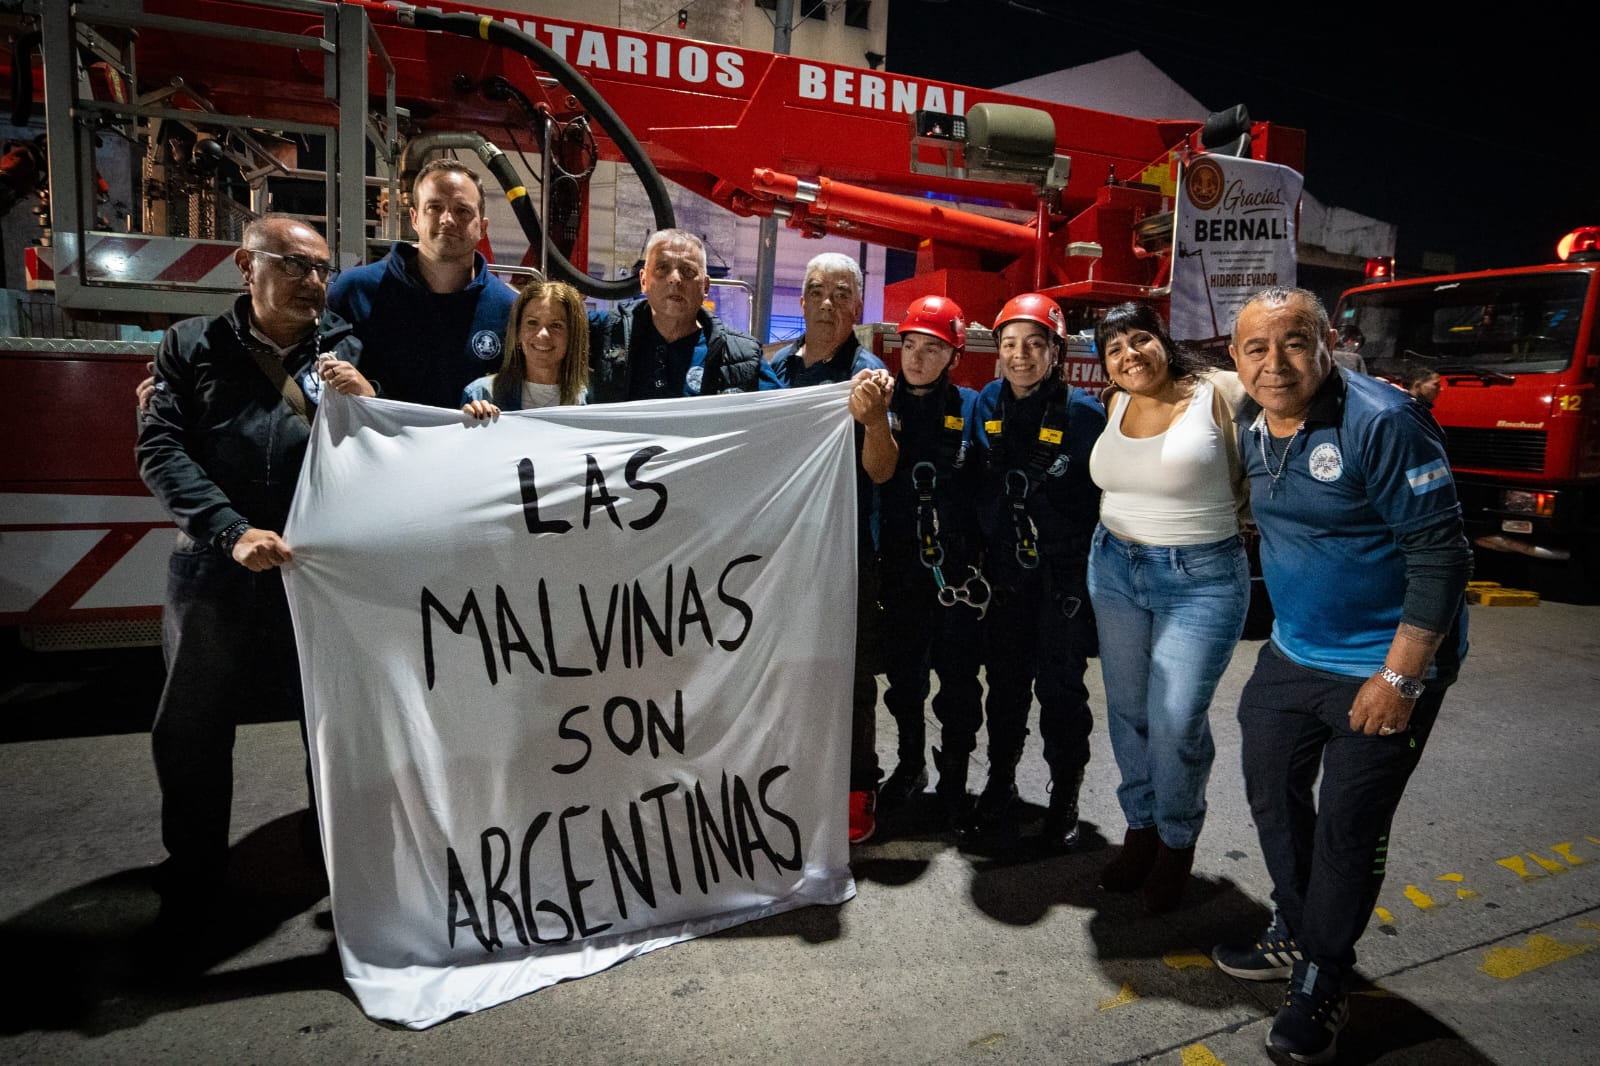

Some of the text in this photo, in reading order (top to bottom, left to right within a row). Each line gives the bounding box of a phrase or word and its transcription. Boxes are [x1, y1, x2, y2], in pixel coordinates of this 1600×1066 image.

[1195, 217, 1288, 242] BERNAL!
[1210, 273, 1278, 288] HIDROELEVADOR
[1559, 395, 1582, 411] 12
[517, 446, 669, 534] LAS
[420, 554, 763, 690] MALVINAS
[551, 690, 685, 774] SON
[446, 765, 803, 953] ARGENTINAS
